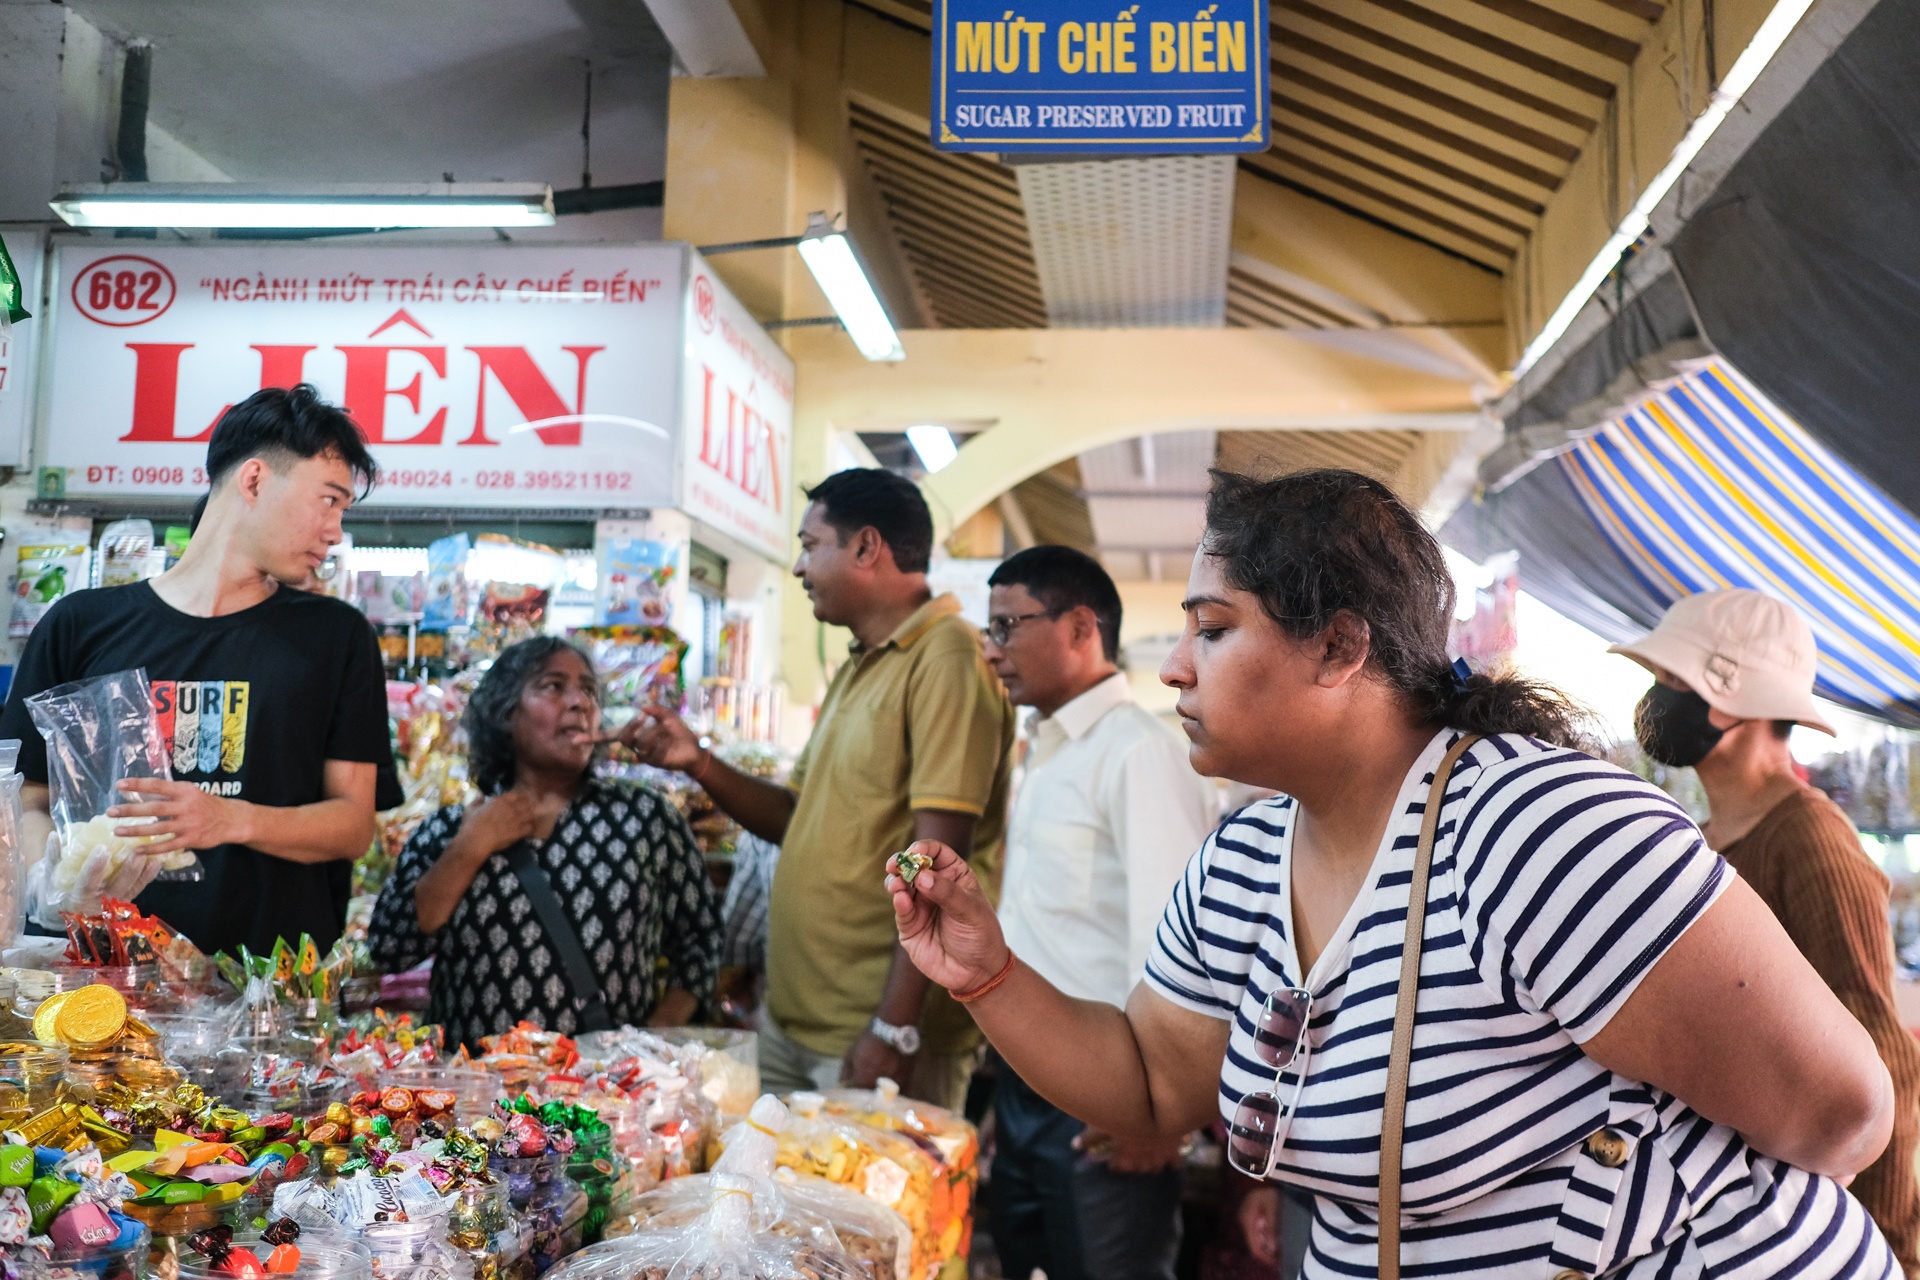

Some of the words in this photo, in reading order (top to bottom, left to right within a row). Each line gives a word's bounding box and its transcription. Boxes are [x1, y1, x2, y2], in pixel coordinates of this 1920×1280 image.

[956, 11, 1045, 73] MỨT
[1058, 5, 1140, 73] CHẾ
[1151, 4, 1246, 73] BIẾN
[956, 105, 1031, 127] SUGAR
[1037, 104, 1172, 128] PRESERVED
[1177, 104, 1246, 127] FRUIT
[90, 271, 161, 310] 682
[318, 271, 375, 301] MỨT
[383, 271, 444, 301] TRÁI
[453, 271, 507, 302] CÂY
[517, 268, 575, 302] CHẾ
[699, 362, 787, 516] LIÊN
[87, 465, 123, 484] ĐT:
[132, 466, 184, 484] 0908
[475, 470, 632, 490] 028.39521192
[155, 686, 244, 714] SURF
[195, 780, 242, 797] OARD
